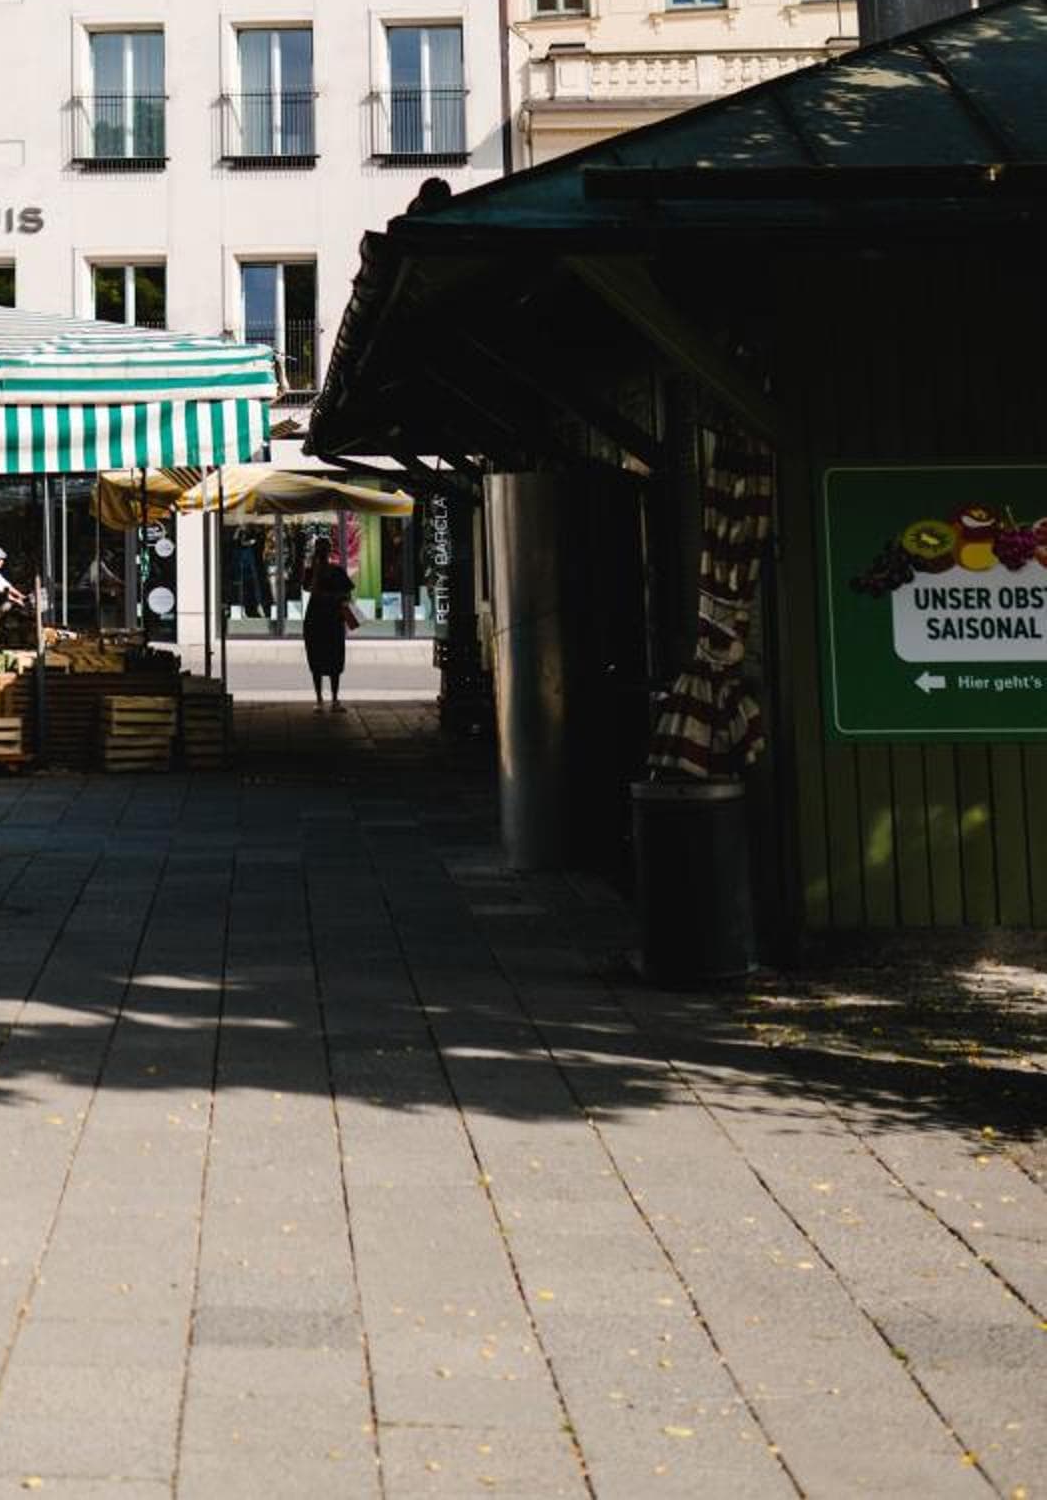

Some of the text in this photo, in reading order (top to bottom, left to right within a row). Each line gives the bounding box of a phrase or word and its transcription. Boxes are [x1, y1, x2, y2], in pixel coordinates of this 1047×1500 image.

[914, 586, 992, 610] UNSER
[926, 617, 1042, 640] SAISONAL
[958, 675, 1043, 692] Hier geht's
